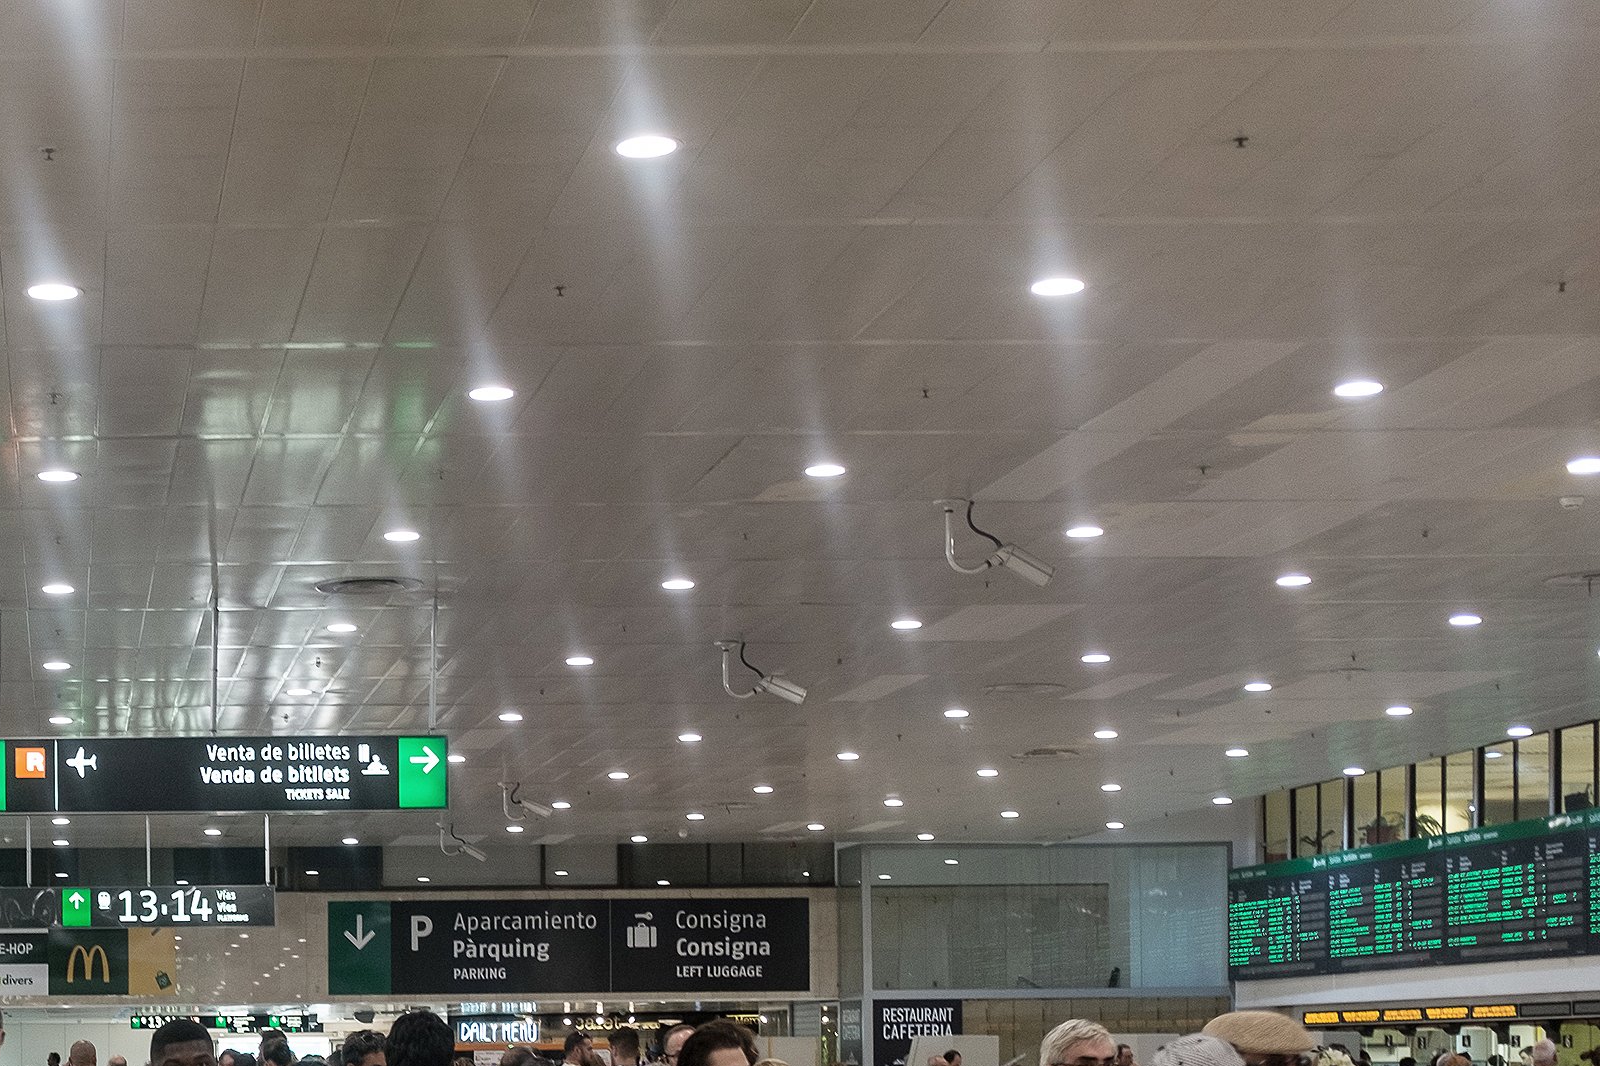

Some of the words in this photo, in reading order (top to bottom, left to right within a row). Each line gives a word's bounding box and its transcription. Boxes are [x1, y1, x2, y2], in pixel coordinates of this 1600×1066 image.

[25, 752, 45, 772] R
[206, 744, 256, 762] Venta
[260, 743, 282, 761] de
[287, 743, 350, 761] billetes
[200, 766, 255, 784] Venda
[260, 765, 283, 783] de
[287, 765, 350, 783] bitllets
[285, 788, 324, 800] TICKETS
[325, 788, 350, 800] SALE
[676, 909, 766, 933] Consigna
[410, 915, 434, 951] P
[453, 911, 597, 935] Aparcamiento
[453, 938, 550, 962] Pàrquing
[676, 936, 771, 960] Consigna
[2, 974, 33, 986] divers
[453, 968, 507, 980] PARKING
[676, 965, 703, 978] LEFT
[707, 965, 763, 978] LUGGAGE
[882, 1007, 954, 1023] RESTAURANT
[460, 1022, 497, 1042] DAILY
[882, 1023, 953, 1040] CAFETERIA
